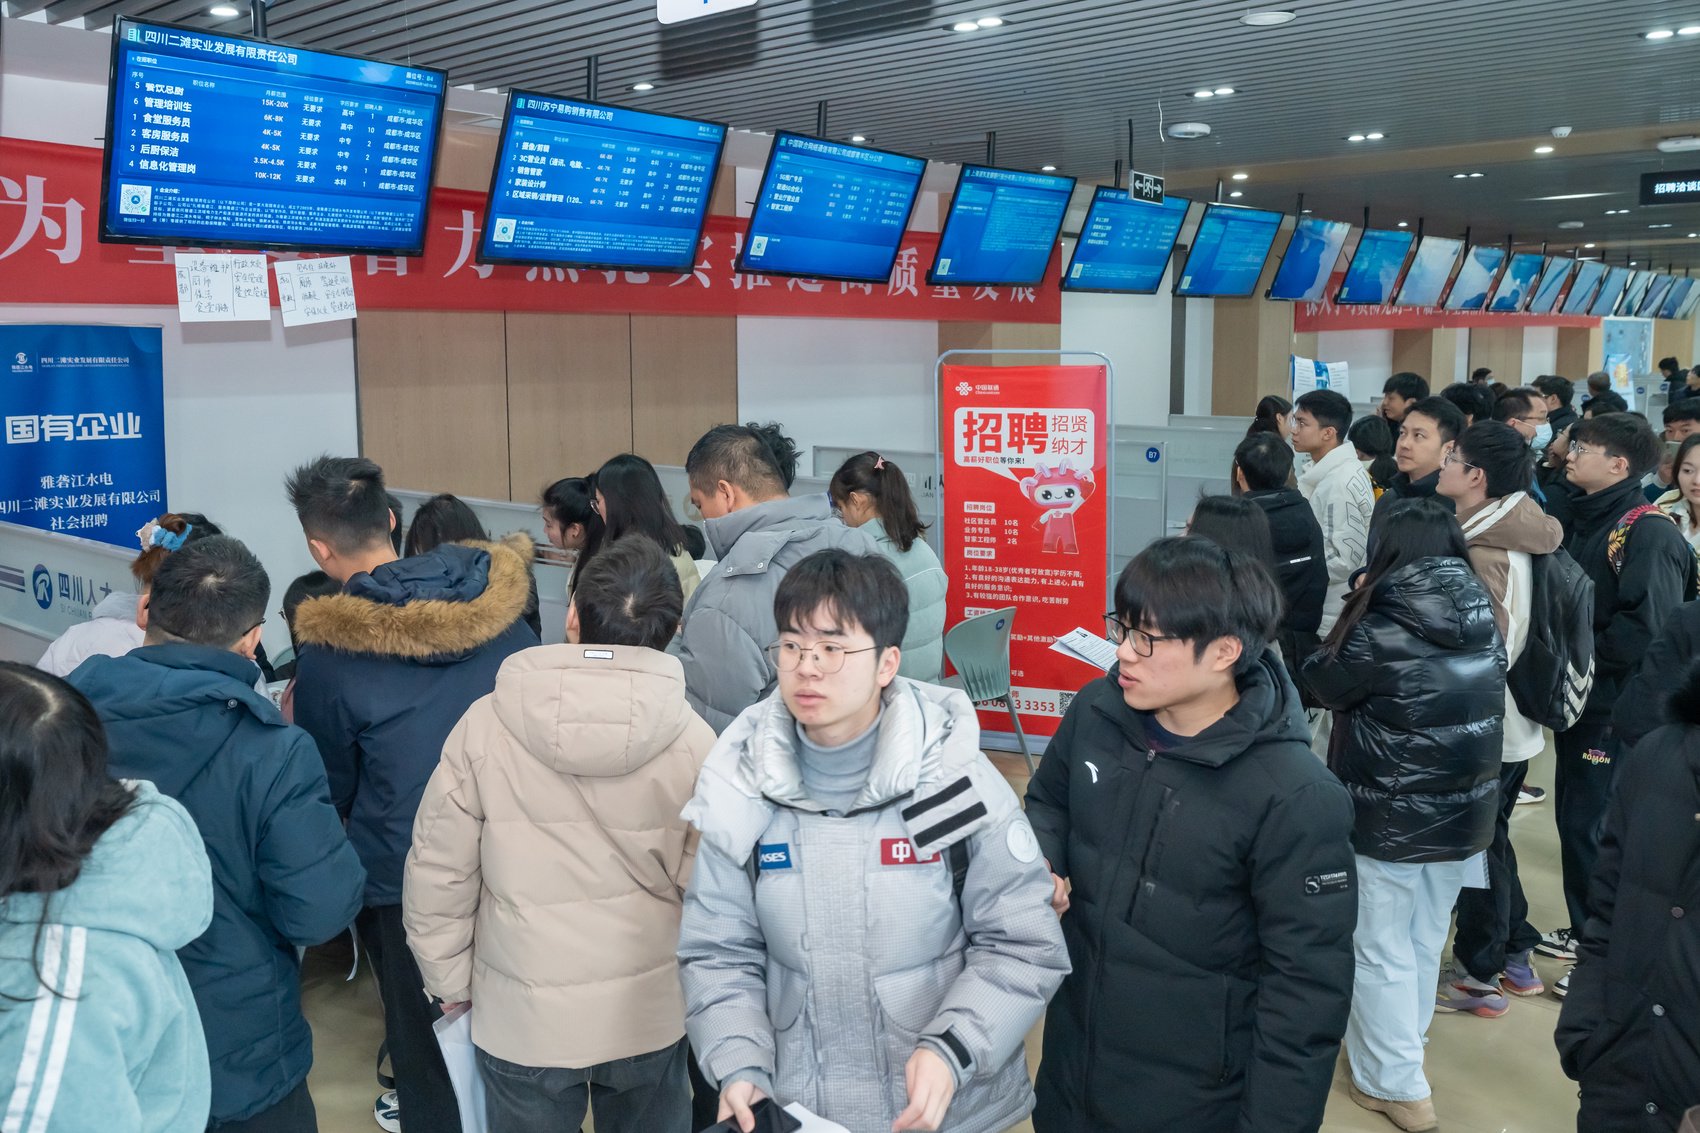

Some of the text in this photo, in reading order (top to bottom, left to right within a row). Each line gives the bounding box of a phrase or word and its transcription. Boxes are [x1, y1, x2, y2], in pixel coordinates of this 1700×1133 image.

[145, 31, 298, 66] 四川二滩实业发展有限责任公司
[131, 71, 144, 79] 序号
[144, 97, 192, 113] 管理培训生
[264, 114, 284, 123] 6K-8K
[301, 118, 322, 128] 无要求
[385, 129, 422, 141] 成都市-成华区
[262, 99, 289, 109] 15K-20K
[303, 104, 323, 114] 无要求
[342, 109, 355, 117] 高中
[387, 115, 424, 127] 成都市-成华区
[527, 99, 614, 122] 四川苏宁易购销售有限公司
[132, 113, 137, 121] 1
[143, 113, 191, 128] 食堂服务员
[262, 129, 282, 137] 4K-5K
[300, 132, 320, 142] 无要求
[339, 137, 352, 145] 中专
[383, 142, 420, 154] 成都市-成华区
[131, 129, 136, 137] 2
[141, 128, 189, 143] 客房服务员
[261, 143, 281, 152] 4K-5K
[298, 147, 319, 156] 无要求
[337, 151, 350, 159] 中专
[382, 155, 418, 166] 成都市-成华区
[521, 142, 550, 153] 摄像/剪辑
[140, 144, 179, 157] 后厨保洁
[253, 157, 285, 166] 3.5K-4.5K
[297, 160, 317, 170] 无要求
[336, 164, 349, 173] 中专
[380, 169, 417, 180] 成都市-成华区
[139, 159, 196, 174] 信息化管理岗
[255, 172, 281, 180] 10K-12K
[295, 175, 315, 184] 无要求
[378, 182, 415, 193] 成都市-成华区
[517, 166, 543, 177] 销售管家
[514, 178, 547, 189] 家装设计师
[5, 412, 143, 444] 国有企业
[963, 411, 1049, 454] 招聘
[1052, 415, 1088, 433] 招贤
[1051, 437, 1088, 455] 纳才
[1148, 451, 1157, 459] B7
[963, 456, 1025, 465] 高薪好职位等你来!
[40, 472, 114, 490] 雅砻江水电
[966, 503, 993, 512] 招聘岗位
[50, 513, 108, 531] 社会招聘
[964, 517, 1019, 527] 社区营业员 10名
[964, 527, 1019, 536] 业务专员 10名
[964, 535, 997, 544] 智家工程师
[966, 549, 993, 557] 岗位要求
[1024, 700, 1055, 712] 3353
[1582, 752, 1611, 765] ROMON
[892, 841, 911, 862] 中
